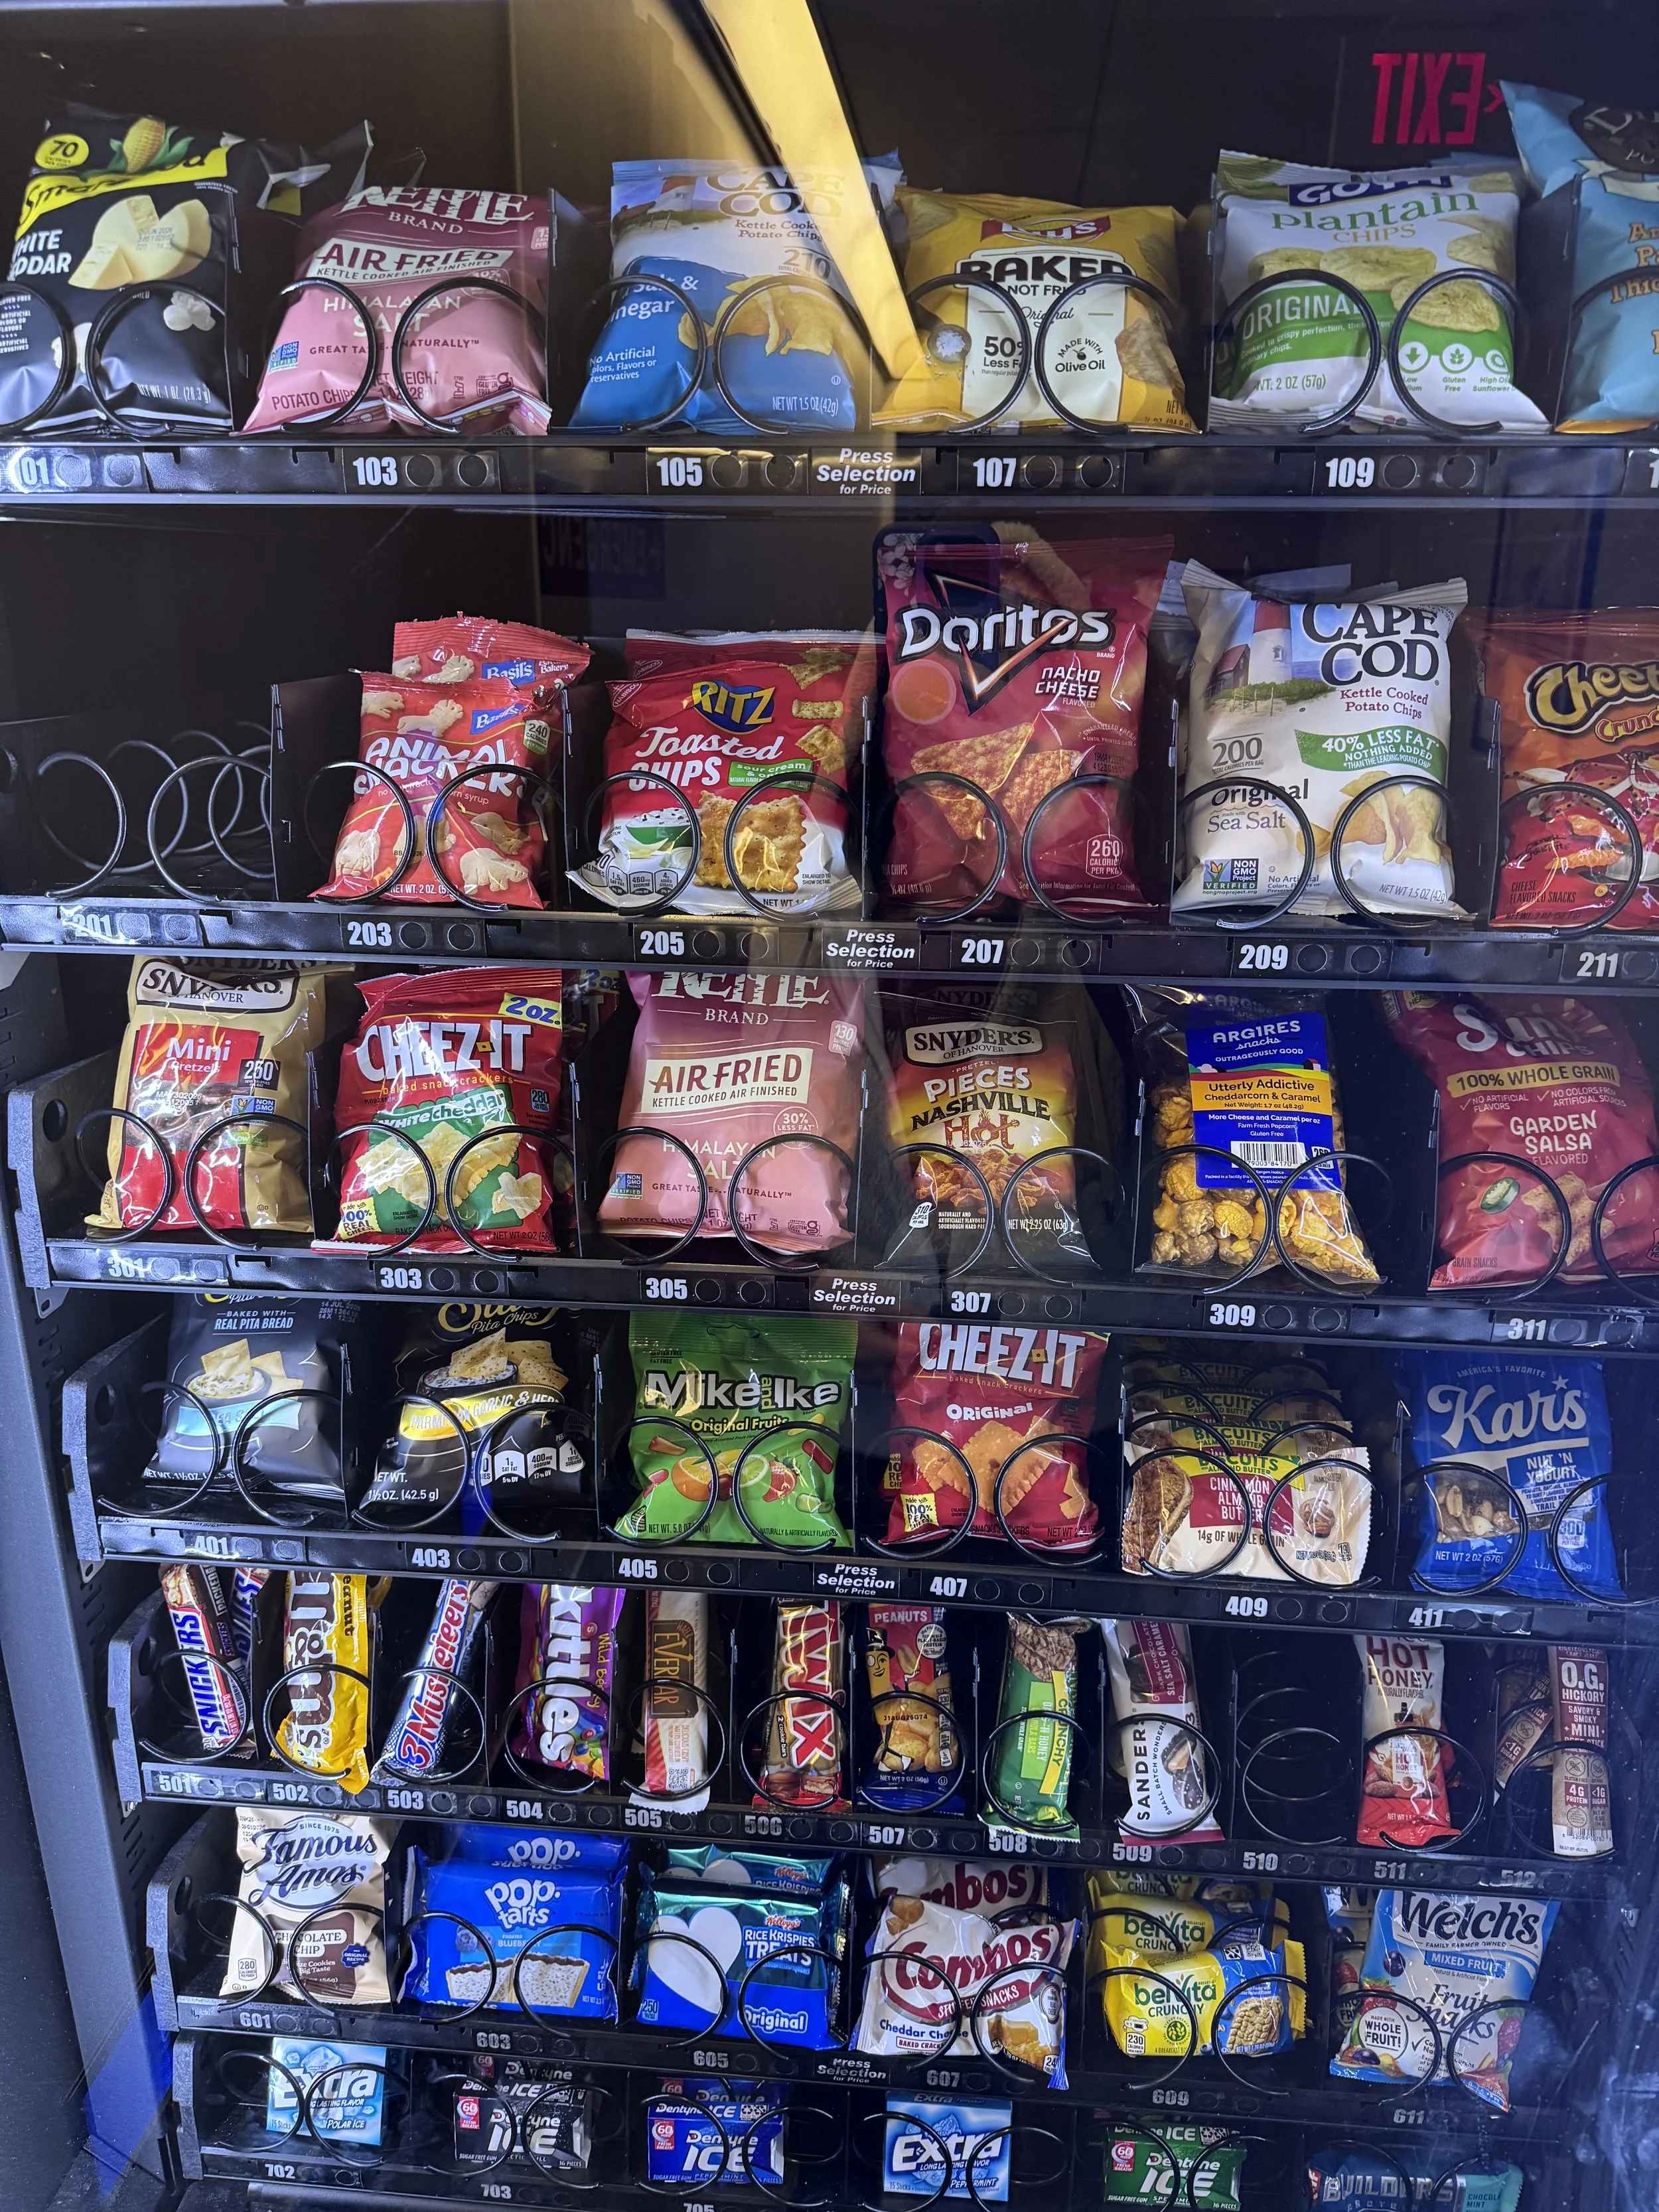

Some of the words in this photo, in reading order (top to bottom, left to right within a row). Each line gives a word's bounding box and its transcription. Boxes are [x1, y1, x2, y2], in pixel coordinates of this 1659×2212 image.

[720, 192, 841, 216] COD
[388, 212, 464, 234] BRAND
[1333, 224, 1415, 243] CHIPS
[317, 244, 391, 271] AIR
[394, 250, 499, 271] FRIED
[959, 256, 1135, 283] BAKED
[983, 357, 1009, 368] Less
[1055, 361, 1087, 372] Olive
[1089, 360, 1106, 371] Oil
[839, 449, 893, 463] Press
[353, 457, 397, 485] 103
[658, 458, 703, 487] 105
[816, 466, 915, 482] Selection
[974, 458, 1017, 487] 107
[1326, 458, 1374, 488] 109
[839, 484, 857, 494] for
[860, 484, 891, 494] Price
[899, 605, 1112, 657] Doritos
[1302, 603, 1439, 644] CAPE
[1321, 640, 1439, 686] COD
[1041, 668, 1100, 682] NACHO
[1035, 680, 1098, 699] CHEESE
[1340, 688, 1383, 699] Kettle
[1386, 688, 1428, 705] Cooked
[693, 680, 775, 726] RITZ
[1346, 701, 1388, 713] Potato
[1394, 703, 1422, 719] Chips
[530, 723, 547, 738] 240
[635, 727, 783, 759] Toasted
[1212, 737, 1263, 767] 200
[1322, 737, 1364, 753] 40%
[1368, 733, 1402, 747] LESS
[628, 757, 722, 791] CHIPS
[1208, 815, 1242, 834] Sea
[1246, 813, 1285, 829] Salt
[1091, 840, 1120, 857] 260
[1511, 880, 1536, 892] CHEESE
[348, 922, 392, 946] 203
[641, 931, 685, 955] 205
[847, 930, 895, 943] Press
[826, 944, 914, 958] Selection
[962, 940, 1003, 963] 207
[1239, 945, 1288, 970] 209
[865, 960, 893, 968] Price
[1577, 952, 1619, 977] 211
[704, 1009, 769, 1025] BRAND
[834, 1025, 854, 1041] 130
[914, 1030, 1035, 1051] SNYDER'S
[167, 1037, 231, 1061] Mini
[1235, 1037, 1281, 1051] snacks
[1215, 1049, 1278, 1062] OUTRAGEOUSLY
[460, 1076, 514, 1085] crackers
[649, 1065, 711, 1094] AIR
[713, 1055, 802, 1088] FRIED
[1457, 1074, 1504, 1091] 100%
[1507, 1067, 1569, 1083] WHOLE
[1571, 1066, 1615, 1081] GRAIN
[924, 1067, 1031, 1102] PIECES
[1208, 1082, 1253, 1092] Utterly
[1256, 1079, 1315, 1090] Addictive
[532, 1090, 549, 1104] 280
[652, 1096, 685, 1108] KETTLE
[688, 1093, 727, 1104] COOKED
[730, 1089, 747, 1098] AIR
[750, 1087, 797, 1097] FINISHED
[1281, 1094, 1321, 1103] Caramel
[782, 1114, 808, 1125] 30%
[911, 1092, 1050, 1132] NASHVILLE
[1510, 1110, 1597, 1136] GARDEN
[1525, 1133, 1592, 1154] SALSA
[1532, 1154, 1588, 1165] FLAVORED
[380, 1268, 423, 1289] 303
[832, 1278, 877, 1291] Press
[646, 1278, 687, 1299] 305
[814, 1290, 895, 1305] Selection
[849, 1304, 875, 1313] Price
[951, 1292, 991, 1313] 307
[215, 1319, 238, 1330] REAL
[240, 1319, 260, 1329] PITA
[262, 1318, 293, 1329] BREAD
[472, 1321, 500, 1334] Pita
[504, 1313, 538, 1324] Chips
[1210, 1304, 1256, 1327] 309
[1508, 1319, 1546, 1340] 311
[1457, 1365, 1500, 1378] AMERICA'S
[1506, 1365, 1546, 1378] FAVORITE
[646, 1373, 759, 1408] Mike
[762, 1378, 776, 1409] and
[776, 1378, 839, 1408] Ike
[195, 1537, 230, 1555] 401
[412, 1549, 450, 1568] 403
[618, 1559, 658, 1578] 405
[835, 1564, 877, 1576] Press
[817, 1574, 895, 1589] Selection
[930, 1577, 967, 1597] 407
[1226, 1596, 1267, 1617] 409
[874, 1611, 927, 1623] PEANUTS
[1409, 1609, 1443, 1627] 411
[217, 1622, 233, 1657] SNICKERS
[597, 1633, 611, 1663] Wild
[1366, 1642, 1430, 1670] HOT
[1561, 1661, 1604, 1690] O.G.
[780, 1601, 841, 1769] TWIX
[1562, 1688, 1605, 1702] HICKORY
[1571, 1724, 1599, 1737] MINI
[1153, 1721, 1167, 1763] WONDERS
[159, 1776, 192, 1793] 501
[273, 1785, 309, 1802] 502
[1569, 1786, 1584, 1796] 4G
[388, 1792, 423, 1809] 503
[506, 1801, 543, 1818] 504
[1159, 1795, 1172, 1815] SMALL
[624, 1809, 662, 1827] 505
[745, 1816, 782, 1835] 506
[869, 1826, 904, 1844] 507
[989, 1835, 1027, 1853] 508
[244, 1829, 378, 1874] Famous
[1113, 1843, 1152, 1862] 509
[1243, 1852, 1278, 1871] 510
[1374, 1861, 1407, 1880] 511
[248, 1863, 364, 1906] Amos
[1502, 1870, 1536, 1888] 512
[498, 1905, 549, 1929] tarts
[766, 1915, 800, 1929] Kellogg's
[1401, 1891, 1540, 1945] Welch's
[745, 1930, 768, 1941] RICE
[770, 1929, 814, 1947] KRISPIES
[1431, 1953, 1465, 1966] MIXED
[1467, 1958, 1500, 1972] FRUIT
[981, 1986, 1019, 2007] SNACKS
[240, 2012, 271, 2029] 601
[880, 2020, 925, 2037] Cheddar
[1365, 2020, 1401, 2033] WHOLE
[476, 2032, 511, 2049] 603
[1128, 2035, 1143, 2045] 230
[1365, 2032, 1401, 2047] FRUIT!
[693, 2051, 729, 2068] 605
[833, 2058, 872, 2069] Press
[817, 2065, 887, 2080] Selection
[927, 2070, 960, 2087] 607
[510, 2085, 541, 2097] ICE
[1153, 2089, 1189, 2105] 609
[327, 2119, 351, 2130] POLAR
[352, 2119, 364, 2129] ICE
[1394, 2108, 1424, 2124] 611
[265, 2164, 295, 2179] 702
[481, 2185, 512, 2199] 703
